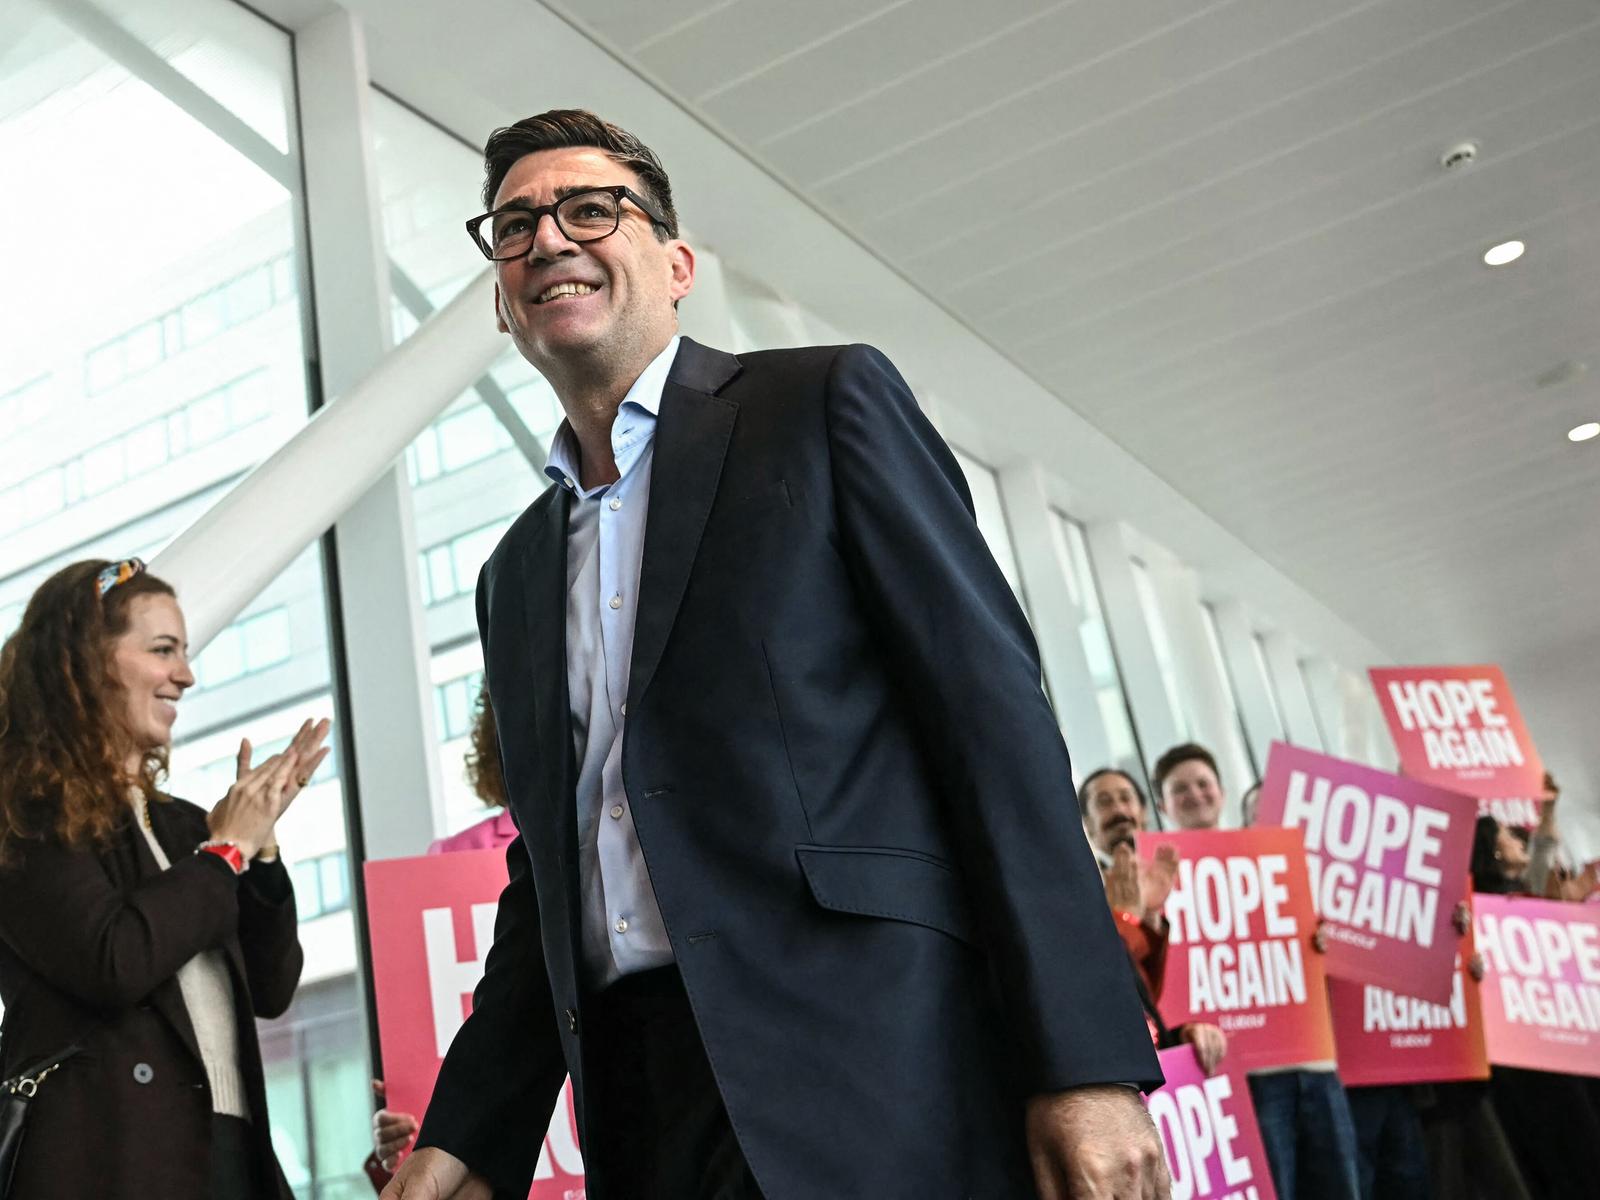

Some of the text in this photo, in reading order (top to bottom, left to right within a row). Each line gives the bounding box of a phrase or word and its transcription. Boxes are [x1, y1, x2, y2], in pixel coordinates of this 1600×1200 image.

[1387, 679, 1508, 731] HOPE
[1421, 727, 1525, 770] AGAIN
[1282, 769, 1450, 887] HOPE
[1164, 854, 1298, 945] HOPE
[1188, 938, 1307, 1014] AGAIN
[1147, 1073, 1254, 1200] OPE
